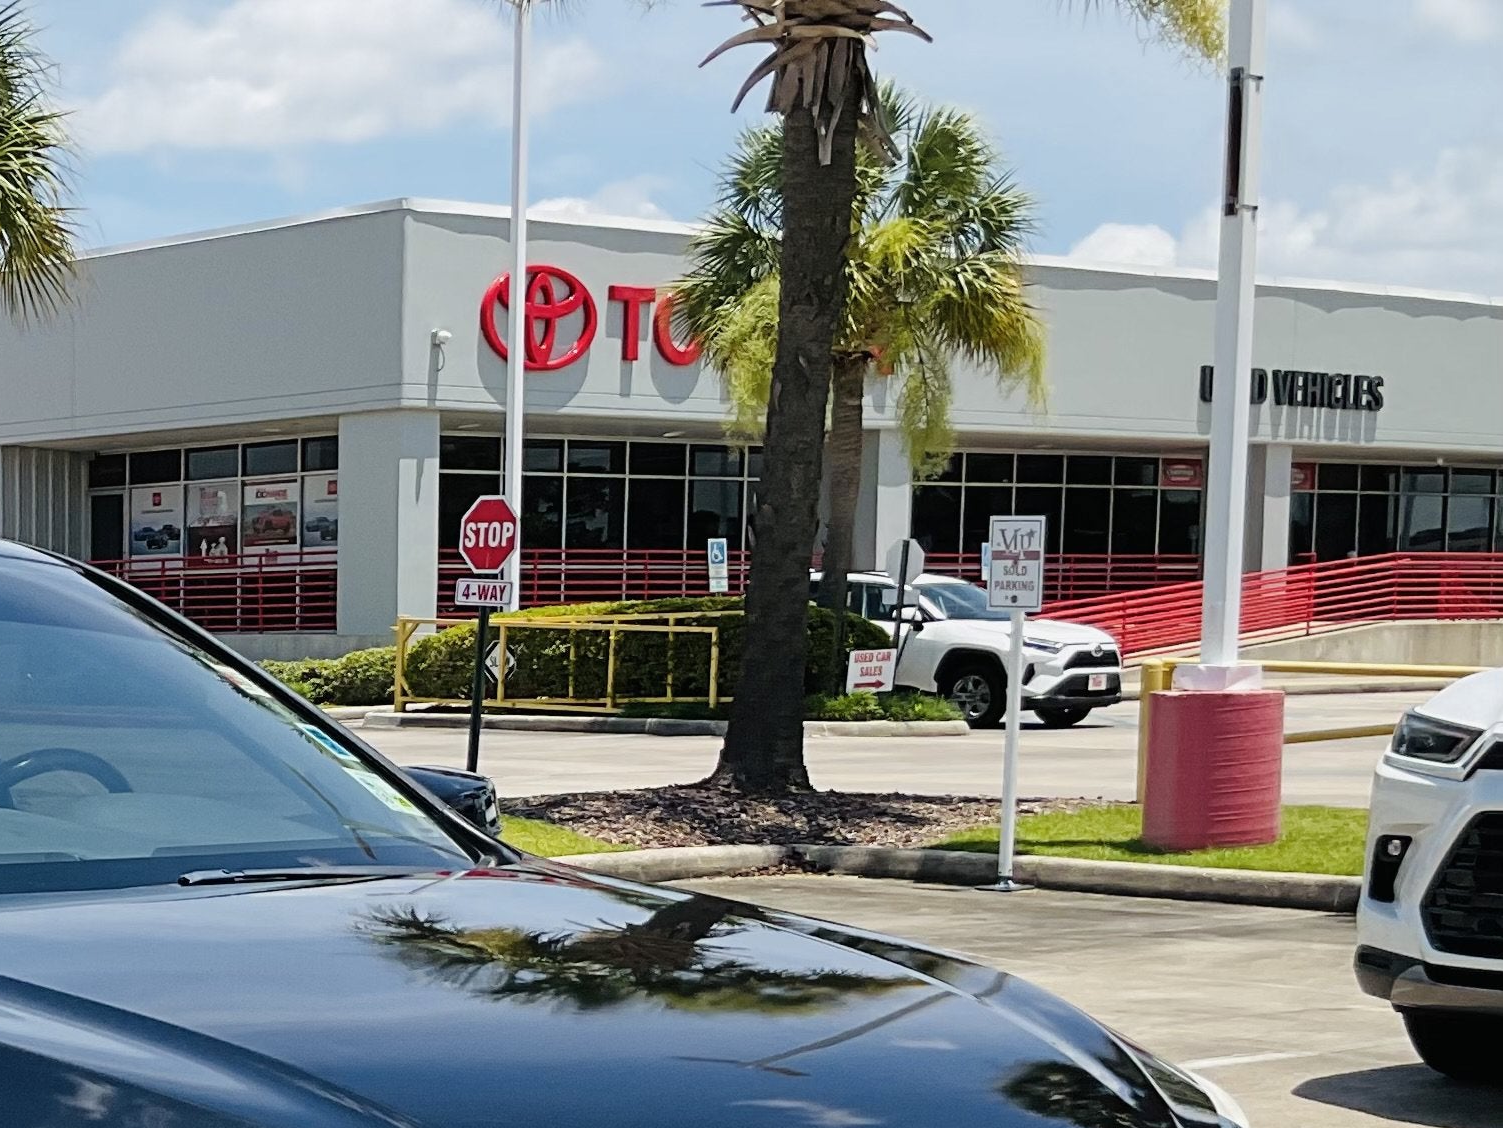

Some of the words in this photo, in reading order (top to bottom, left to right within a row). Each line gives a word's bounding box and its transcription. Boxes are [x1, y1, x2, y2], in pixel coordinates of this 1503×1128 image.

[1200, 365, 1268, 405] UD
[1272, 369, 1384, 412] VEHICLES
[464, 521, 514, 548] STOP
[1003, 565, 1027, 576] SOLD
[994, 580, 1035, 592] PARKING
[462, 584, 506, 601] 4-WAY
[854, 652, 874, 663] USED
[876, 651, 892, 662] CAR
[860, 666, 883, 677] SALES
